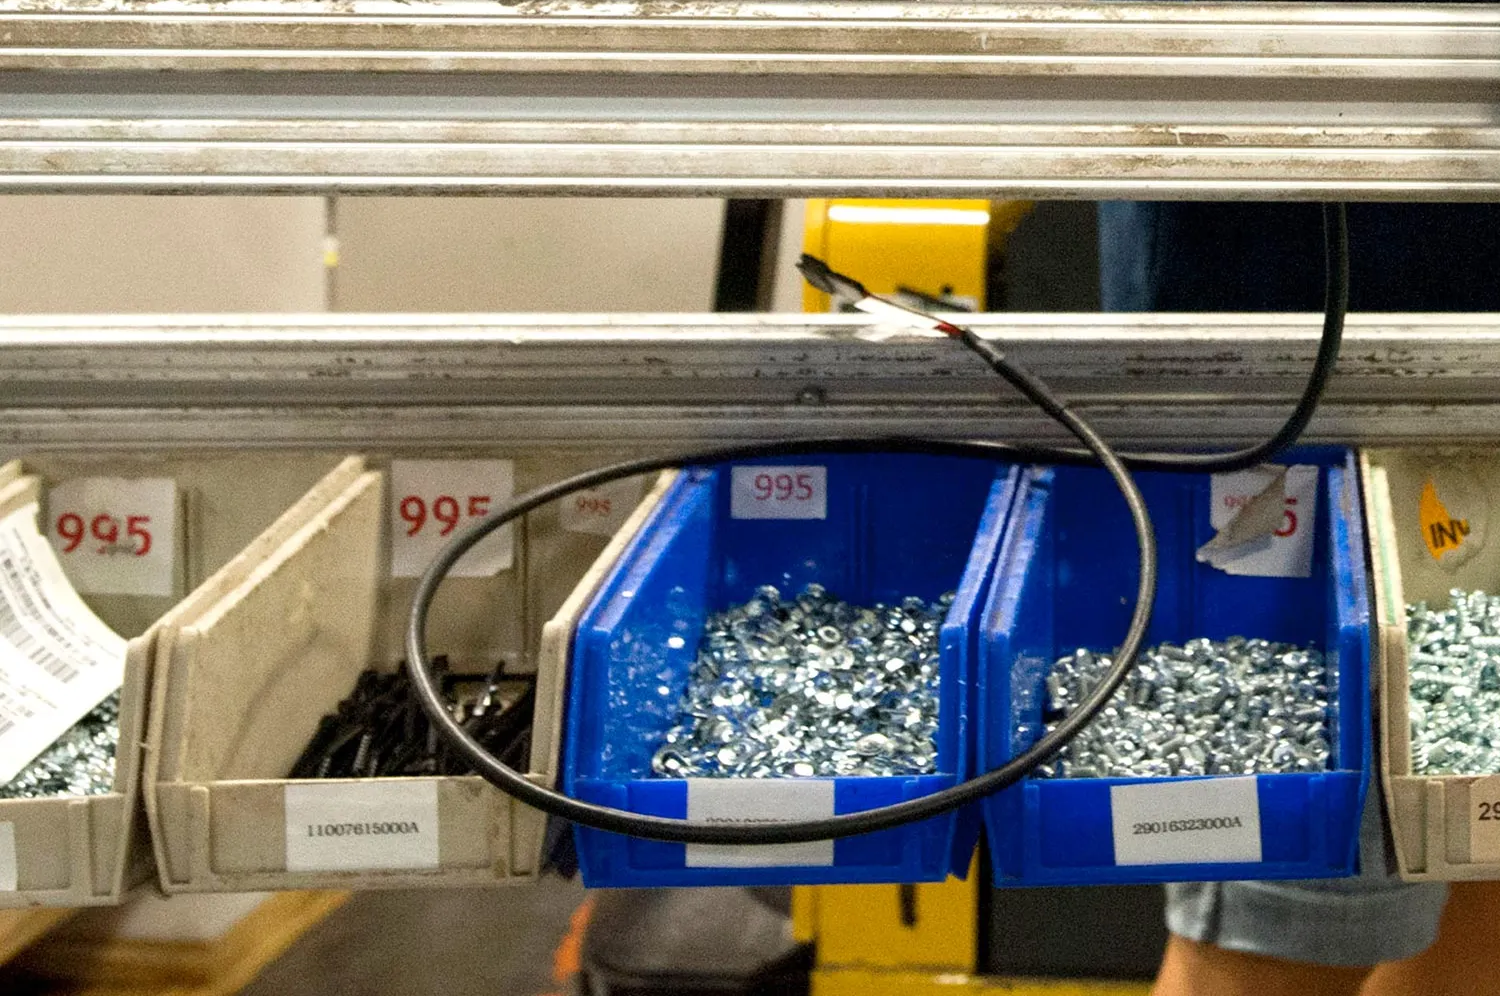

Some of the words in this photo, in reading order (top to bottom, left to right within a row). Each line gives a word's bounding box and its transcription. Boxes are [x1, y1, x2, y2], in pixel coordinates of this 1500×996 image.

[755, 473, 814, 501] 995
[57, 511, 152, 556] 995
[307, 822, 420, 838] 11007615000A
[1132, 815, 1243, 835] 29016323000A
